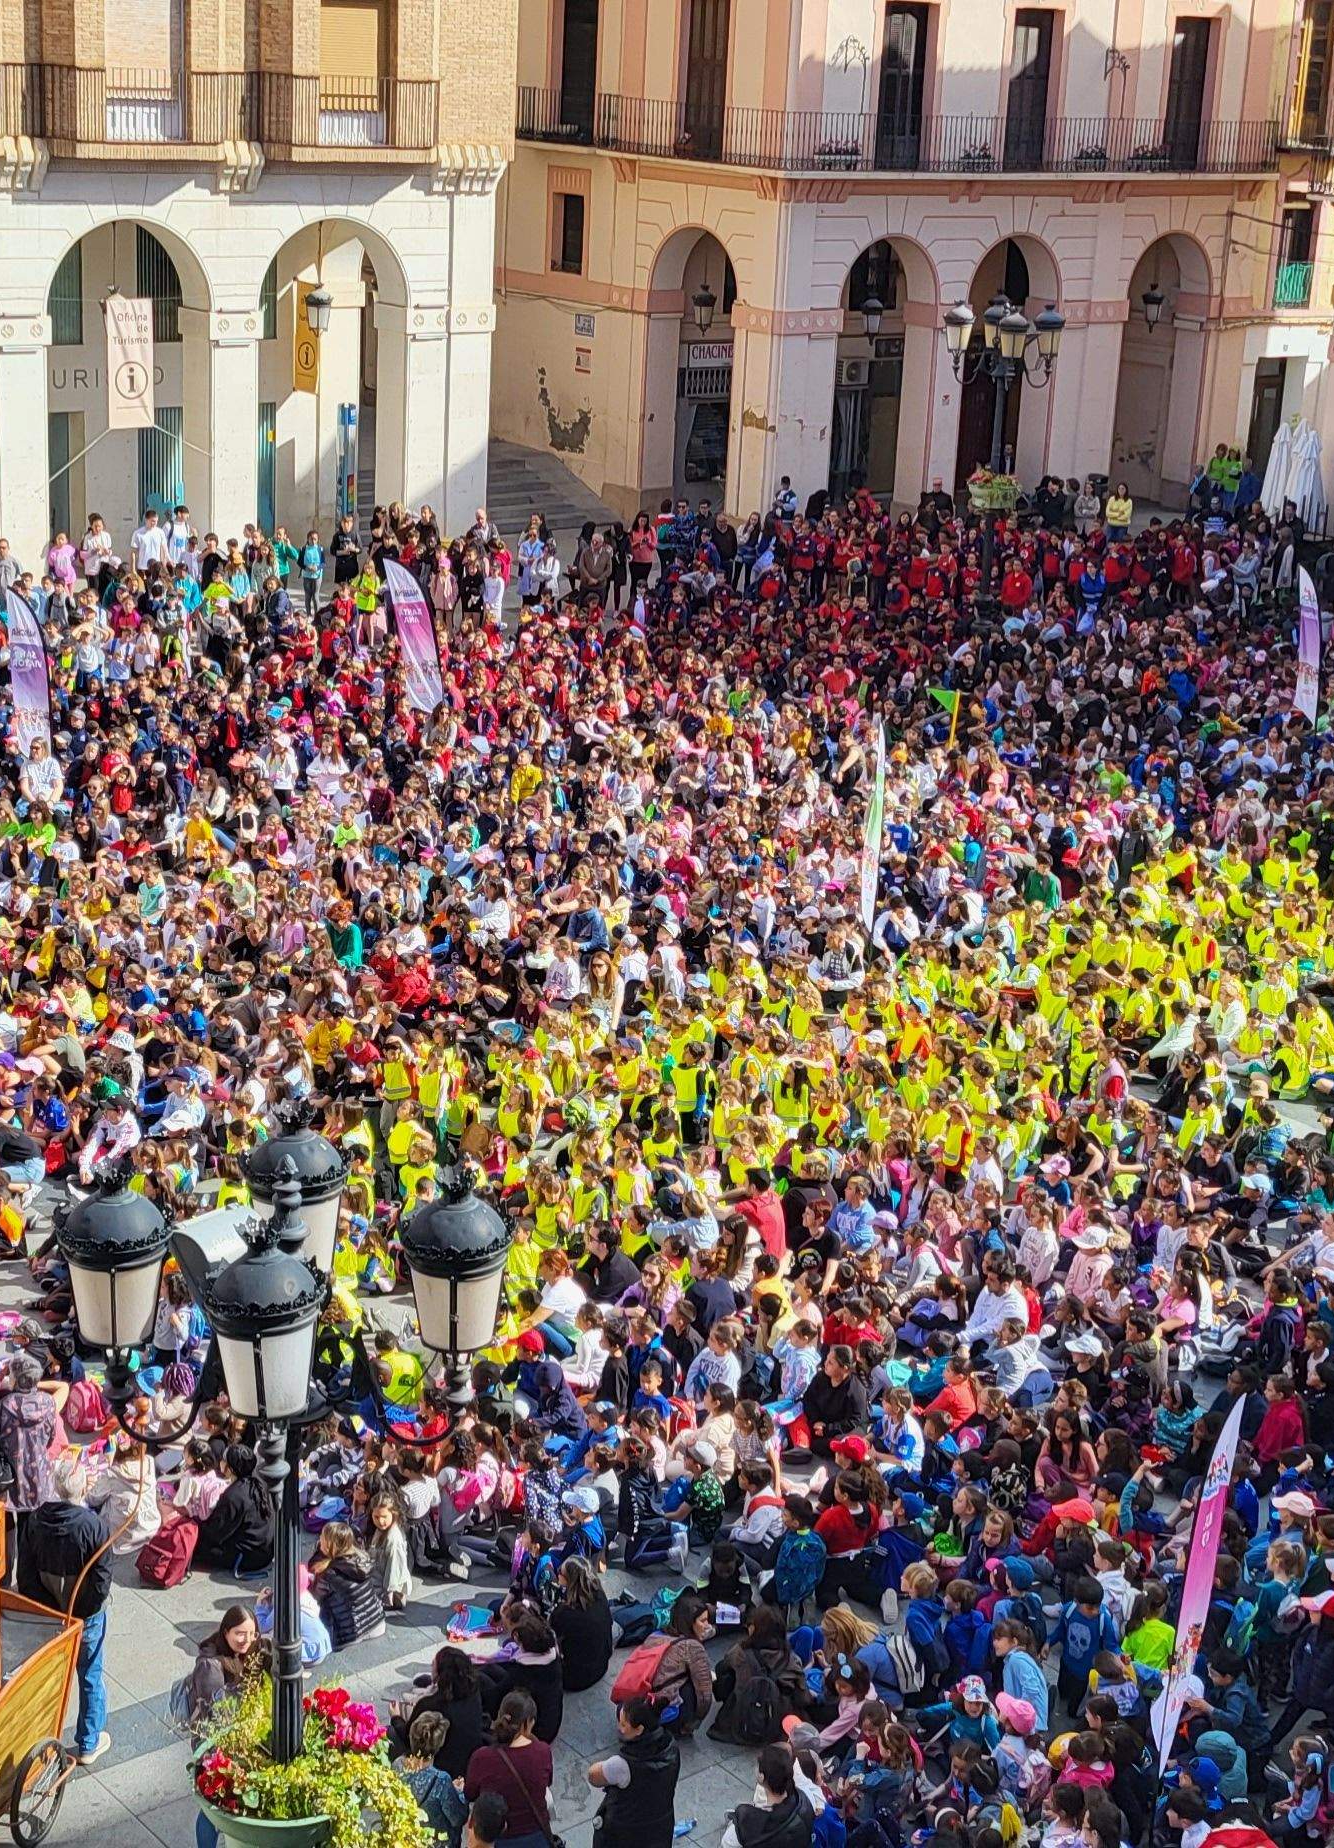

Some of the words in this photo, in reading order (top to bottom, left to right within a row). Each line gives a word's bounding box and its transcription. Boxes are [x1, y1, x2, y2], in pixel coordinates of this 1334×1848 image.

[117, 312, 148, 322] Oficina
[137, 324, 149, 333] de
[112, 335, 149, 346] Turismo
